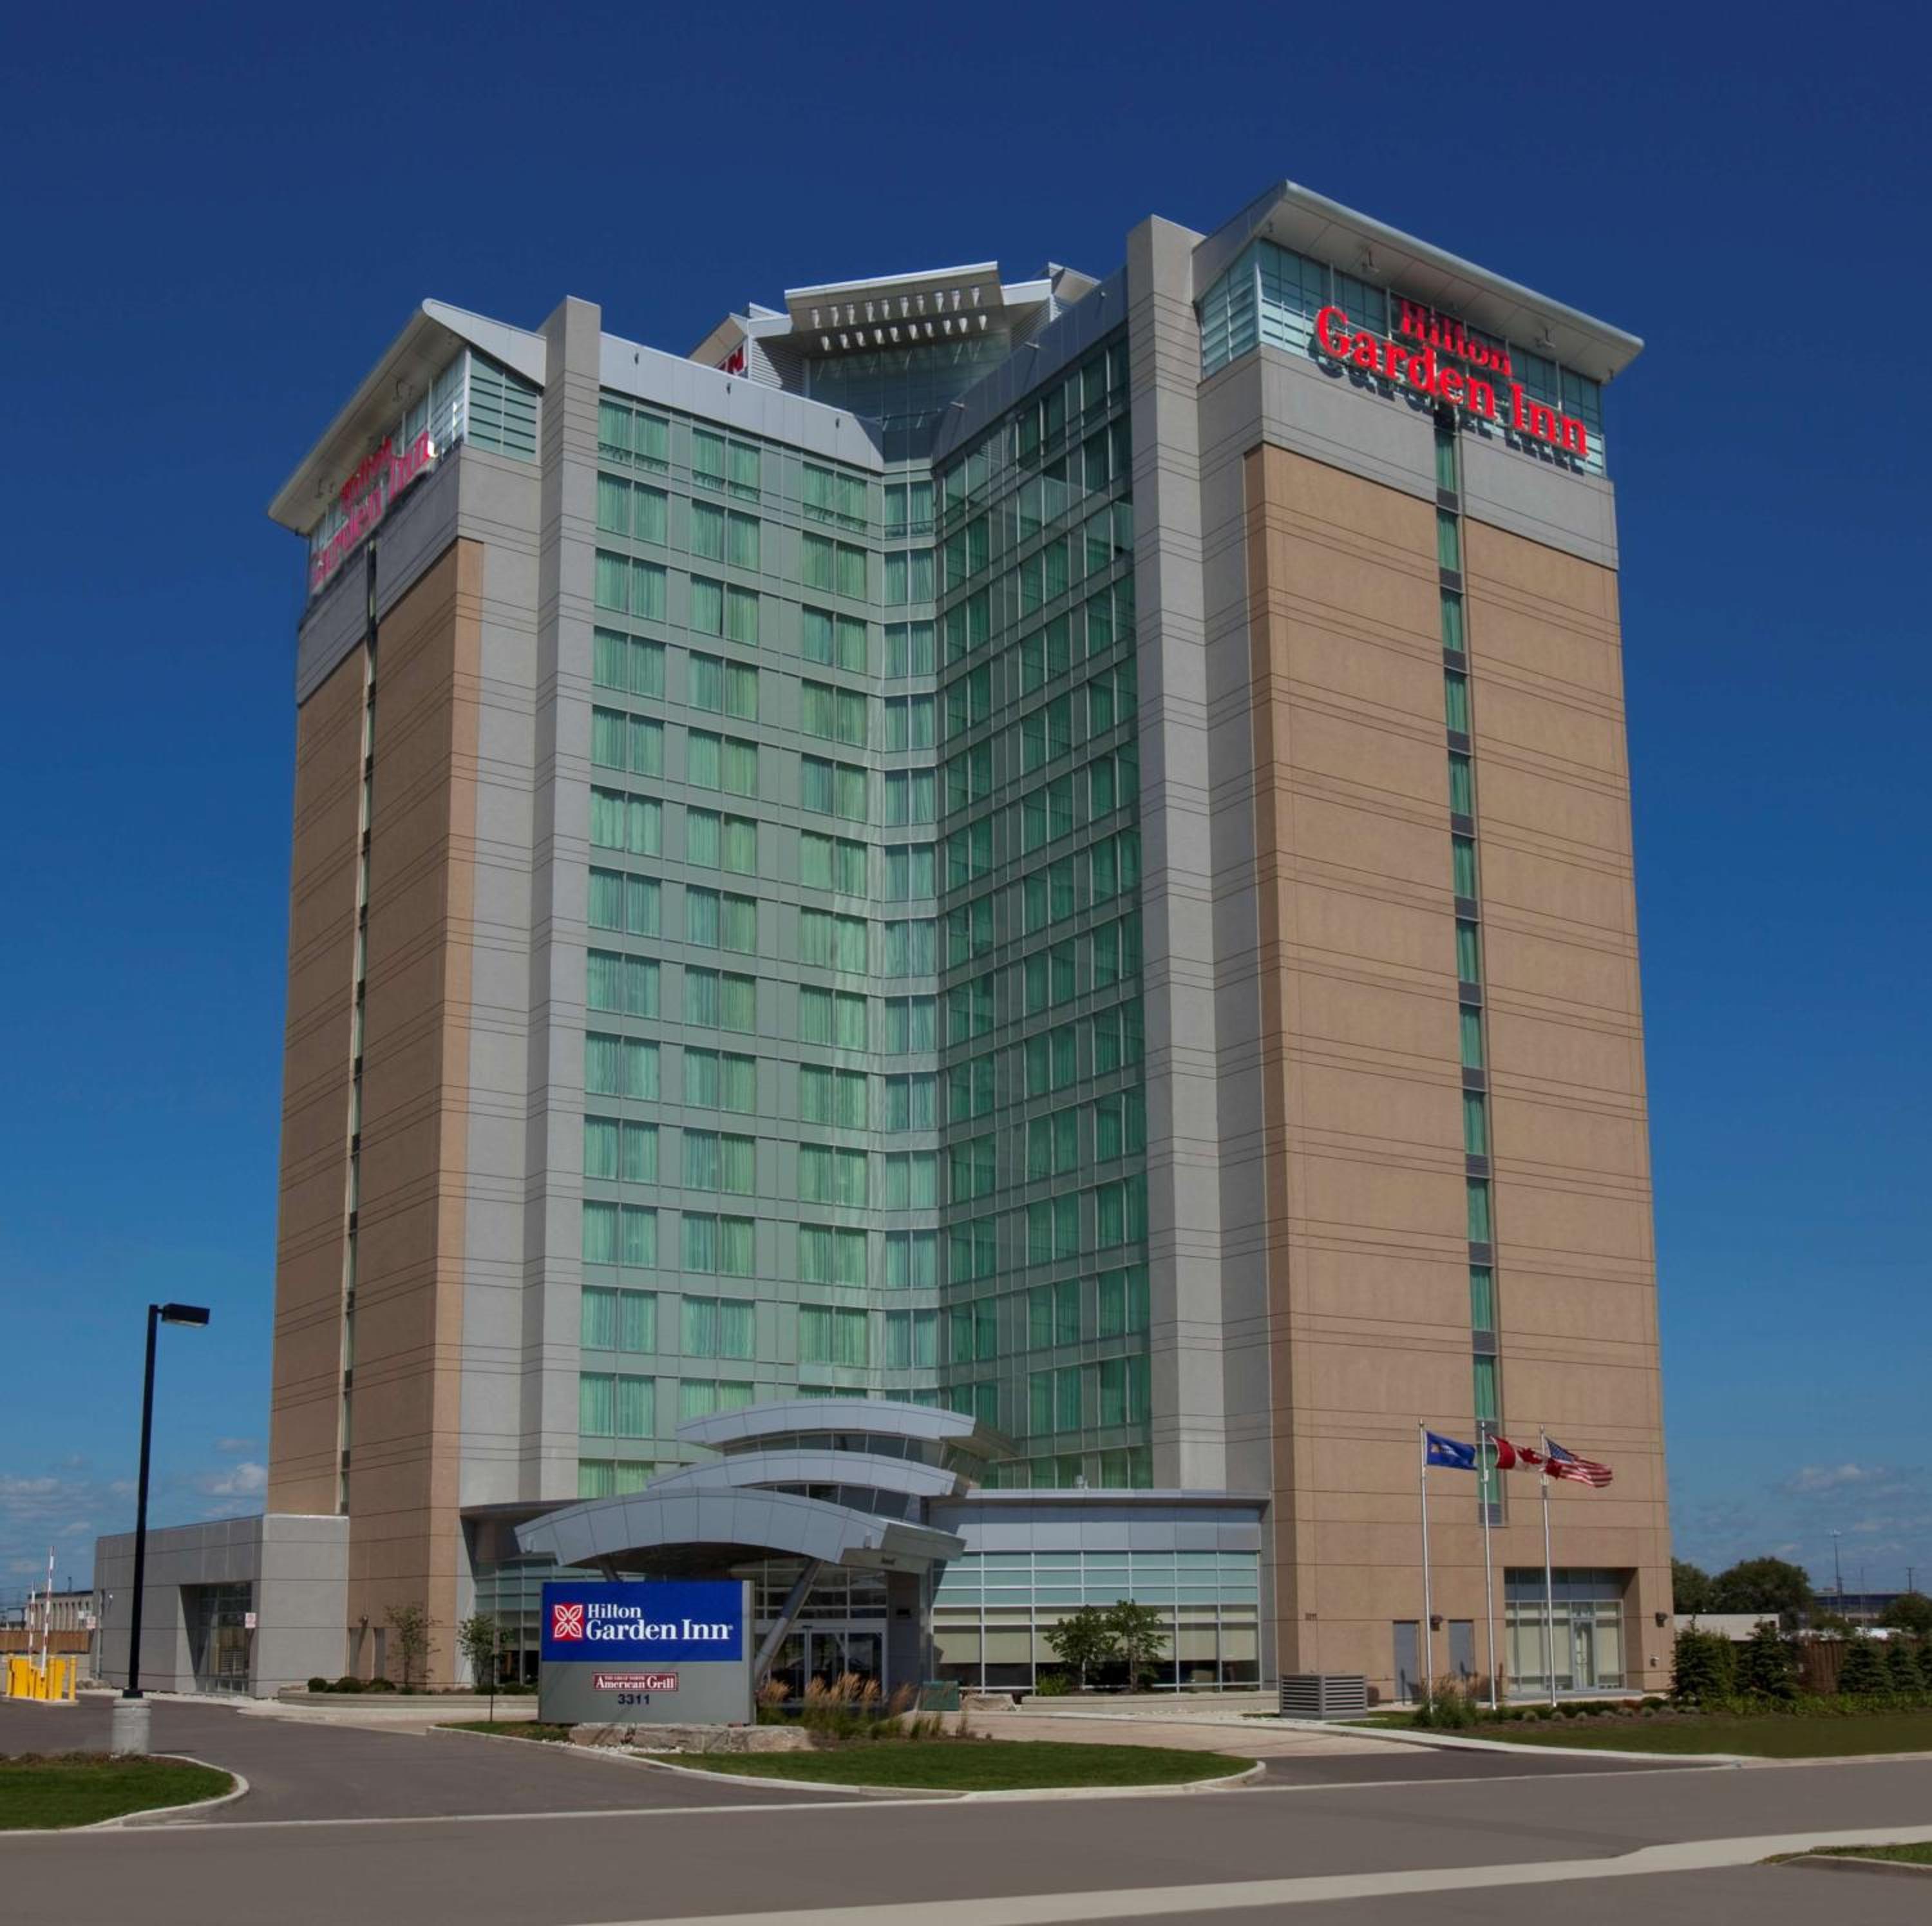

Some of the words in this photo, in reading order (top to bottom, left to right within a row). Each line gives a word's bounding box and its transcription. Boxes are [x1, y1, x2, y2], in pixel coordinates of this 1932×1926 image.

[1399, 299, 1513, 377] Hilton
[1314, 305, 1497, 420] Garden
[1510, 382, 1589, 458] Inn
[587, 1603, 641, 1619] Hilton
[585, 1619, 678, 1641] Garden
[681, 1619, 730, 1640] Inn
[596, 1675, 645, 1688] American
[647, 1675, 674, 1688] Grill
[618, 1693, 650, 1705] 3311
